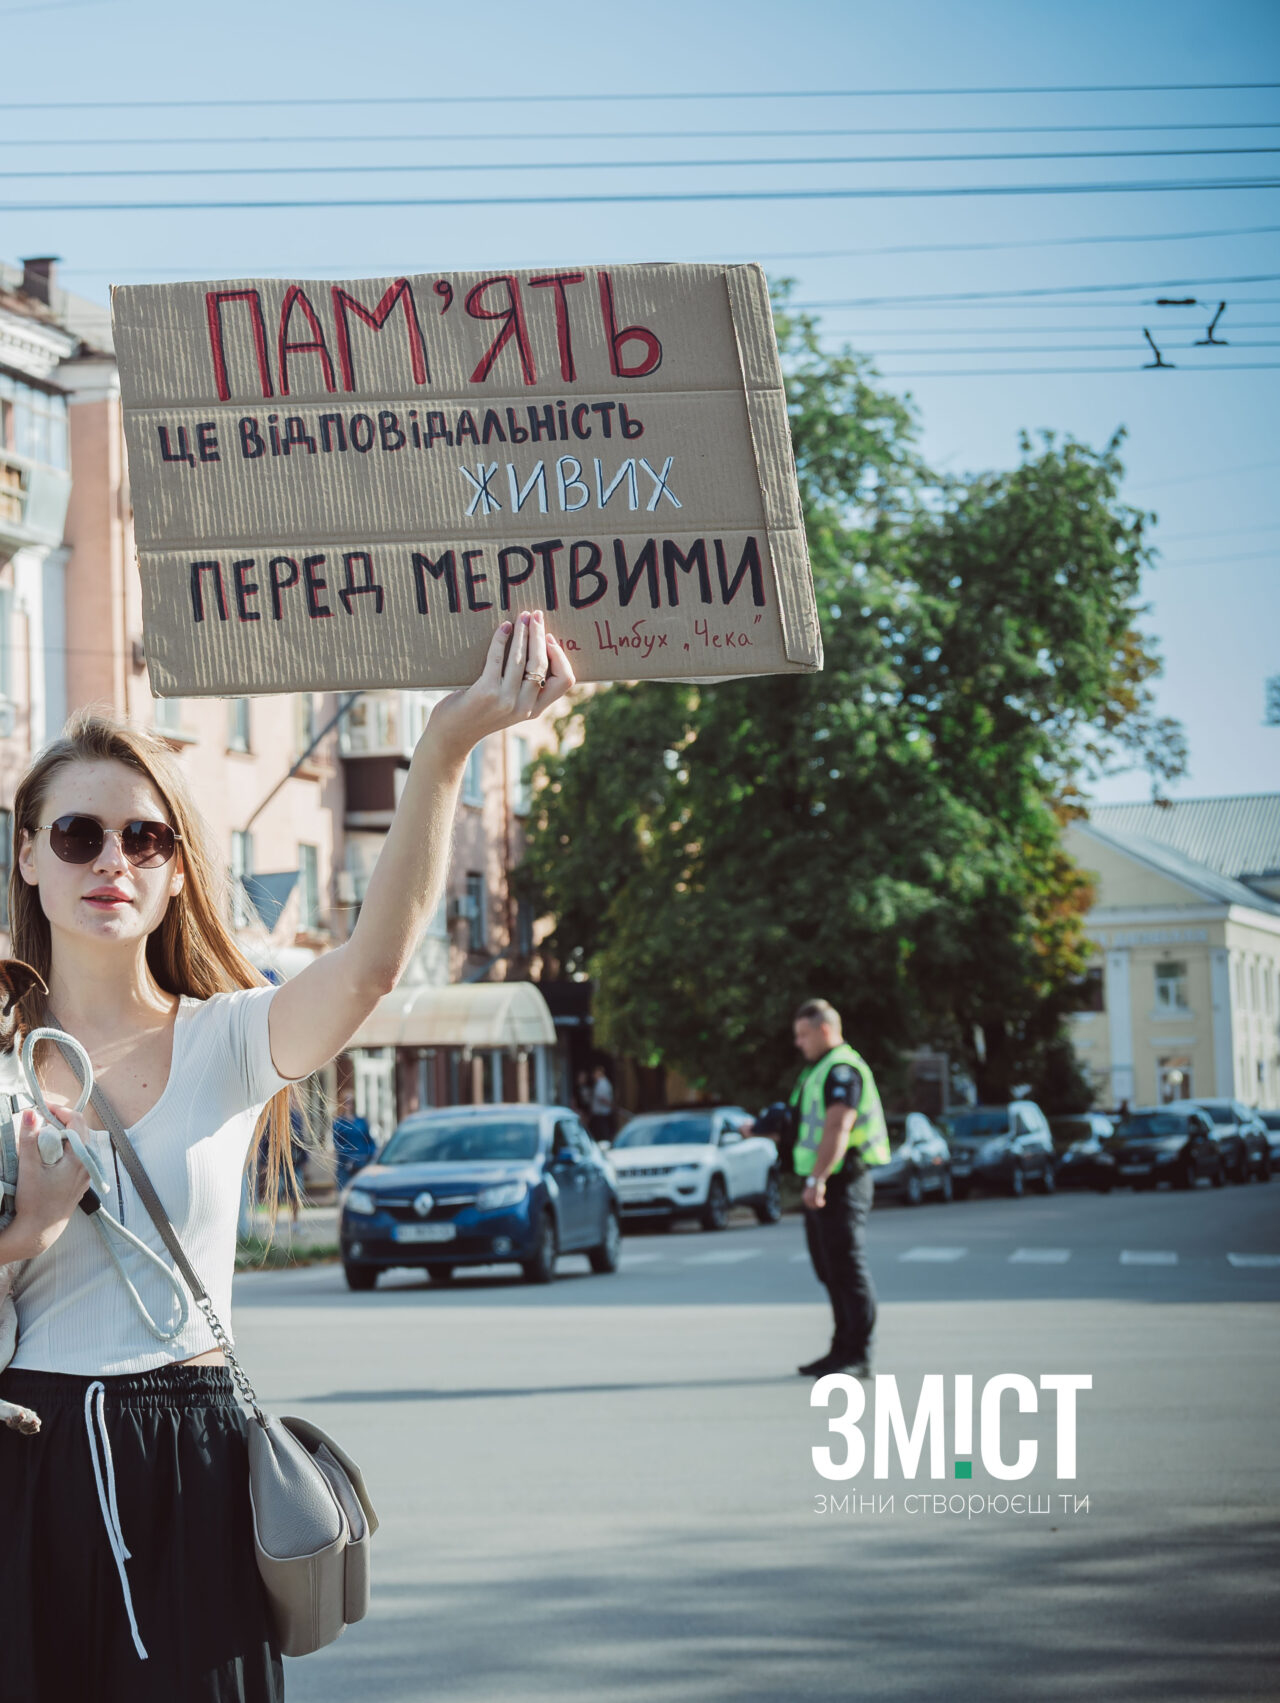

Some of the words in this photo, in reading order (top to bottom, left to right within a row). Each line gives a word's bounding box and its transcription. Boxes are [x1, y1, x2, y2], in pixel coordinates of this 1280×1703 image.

[205, 272, 662, 401] ПАМ'ЯТЬ
[157, 423, 220, 467] ЦЕ
[459, 455, 682, 517] ЖИВИХ
[190, 551, 384, 622] ПЕРЕД
[412, 536, 766, 615] МЕРТВИМИ
[594, 619, 668, 659] Цибух
